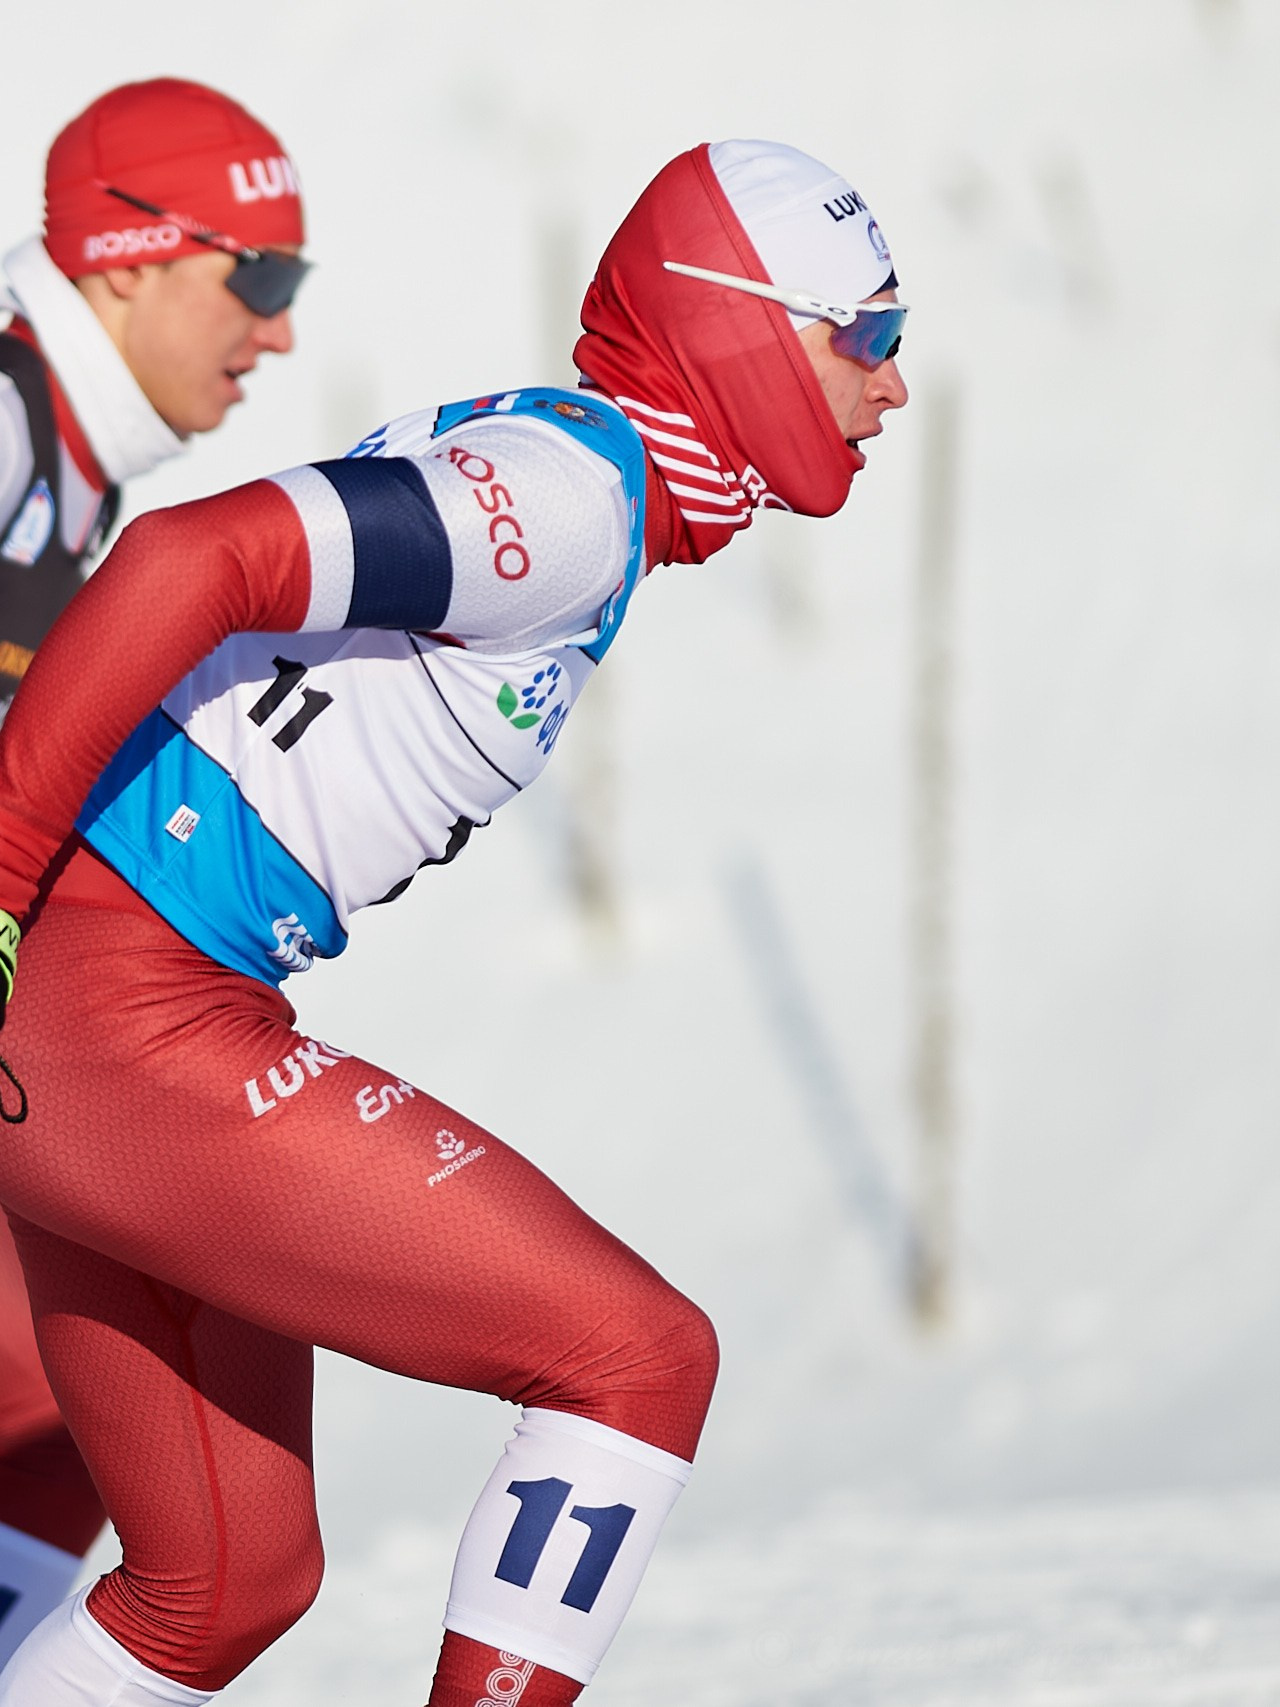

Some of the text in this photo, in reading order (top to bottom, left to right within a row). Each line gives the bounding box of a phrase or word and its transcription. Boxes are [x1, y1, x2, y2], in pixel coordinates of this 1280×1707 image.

[247, 654, 334, 753] 11
[427, 1145, 487, 1188] PHOSAGRO
[494, 1476, 637, 1614] 11
